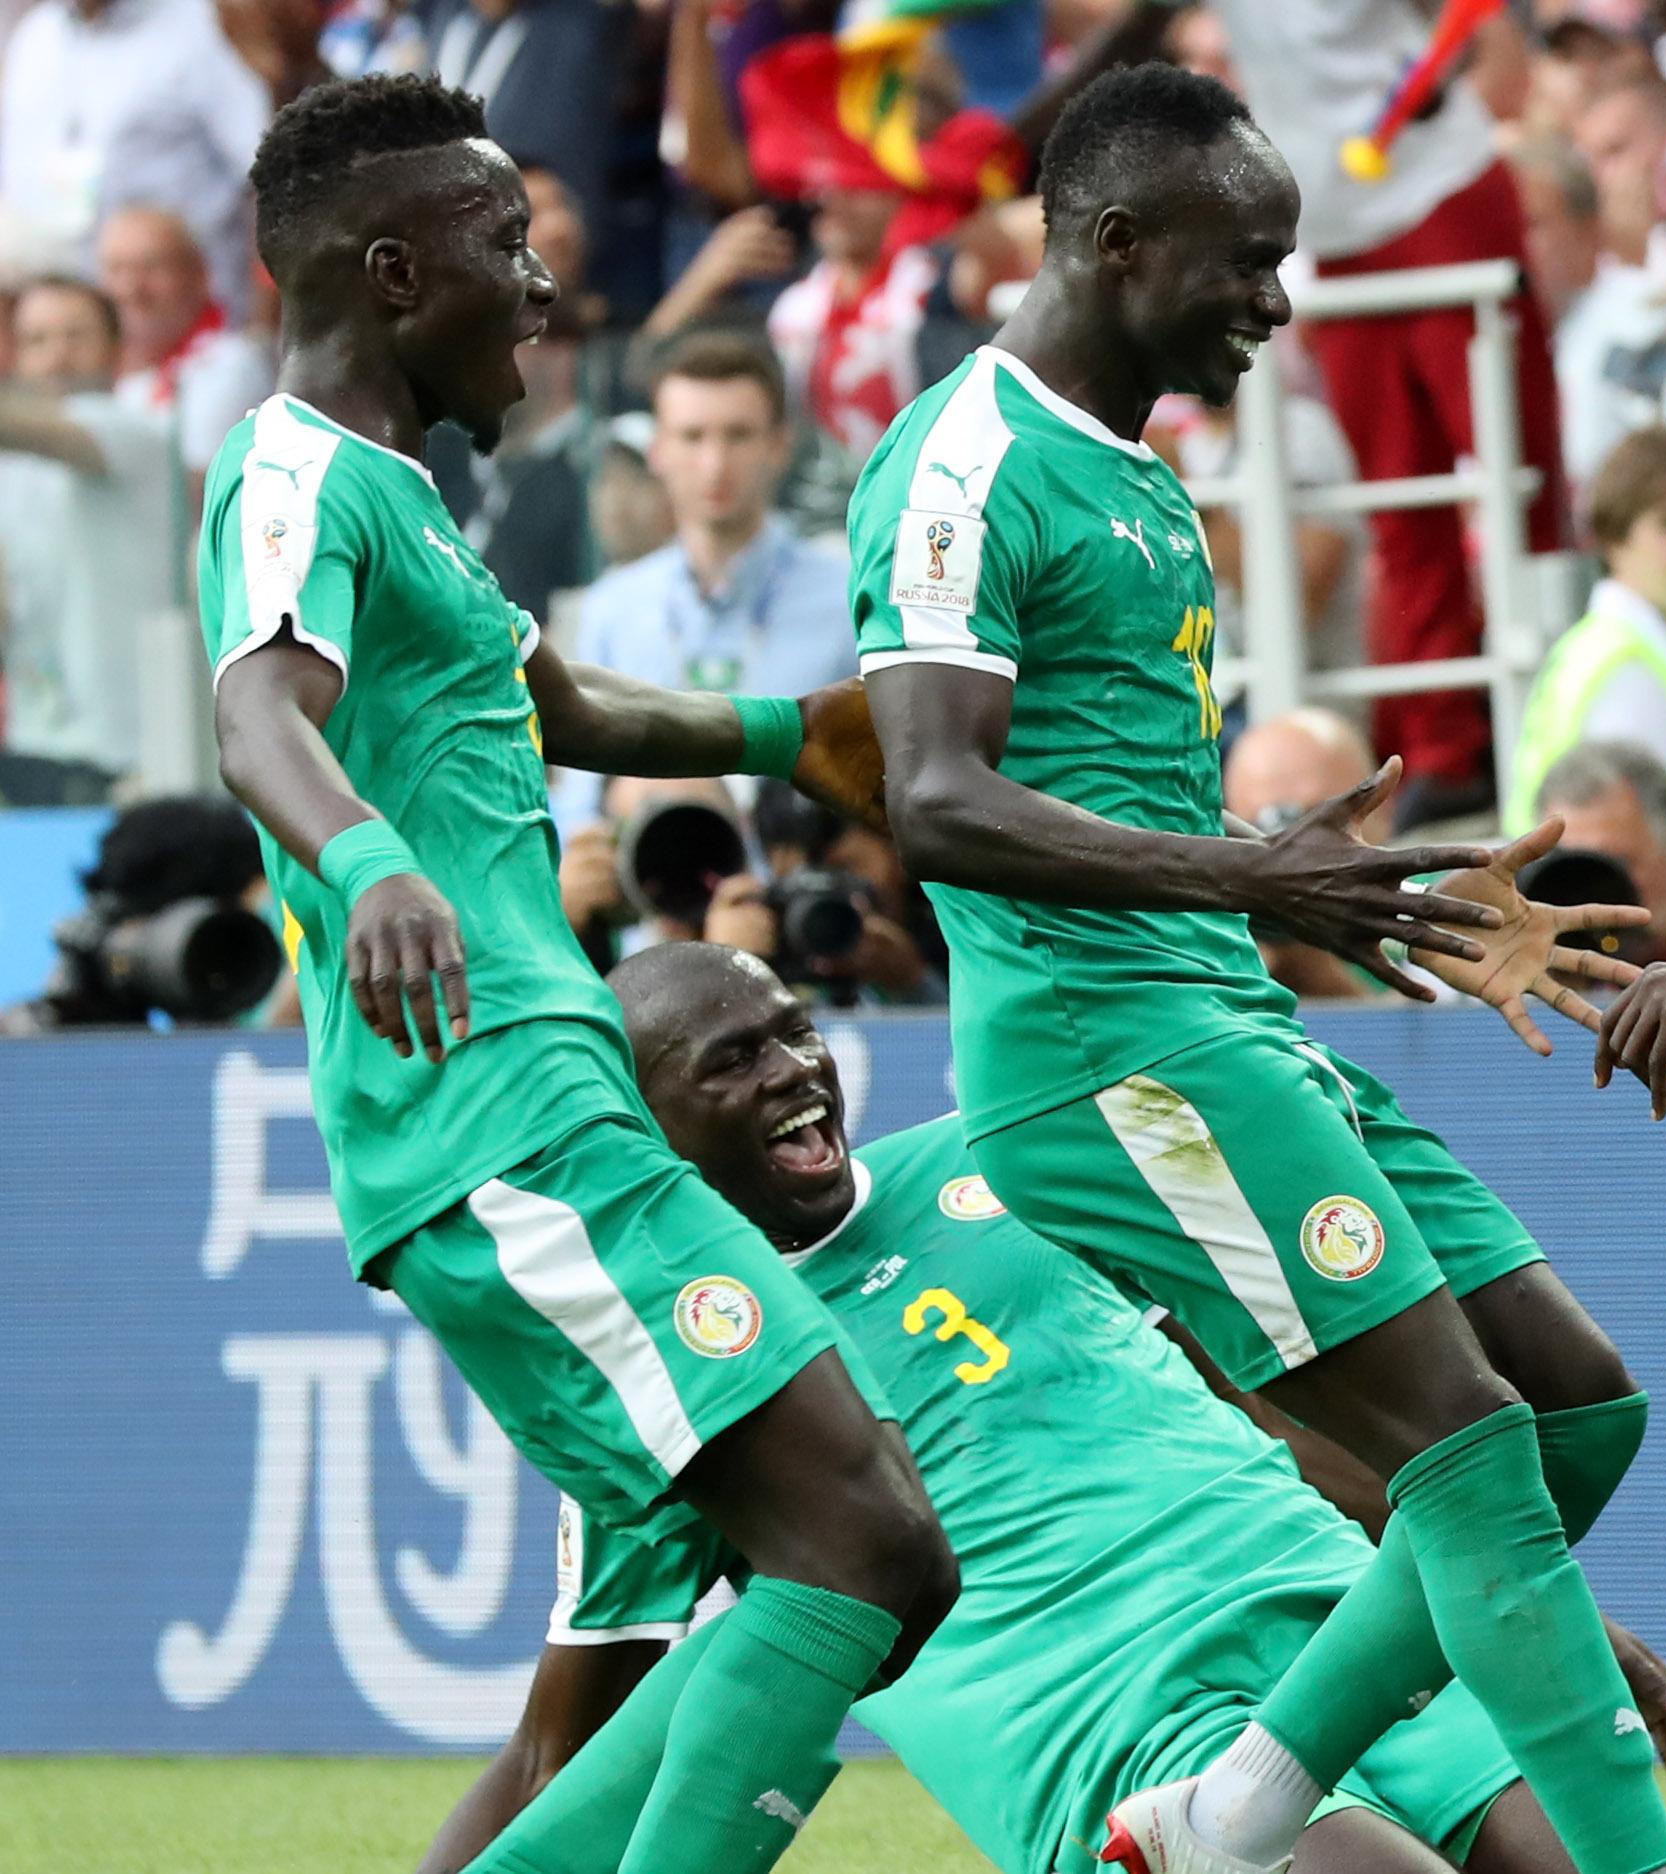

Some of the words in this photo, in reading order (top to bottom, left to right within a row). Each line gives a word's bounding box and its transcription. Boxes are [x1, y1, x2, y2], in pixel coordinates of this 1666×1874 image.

[942, 594, 970, 607] 2018
[1172, 605, 1223, 741] 10
[903, 1288, 1010, 1385] 3
